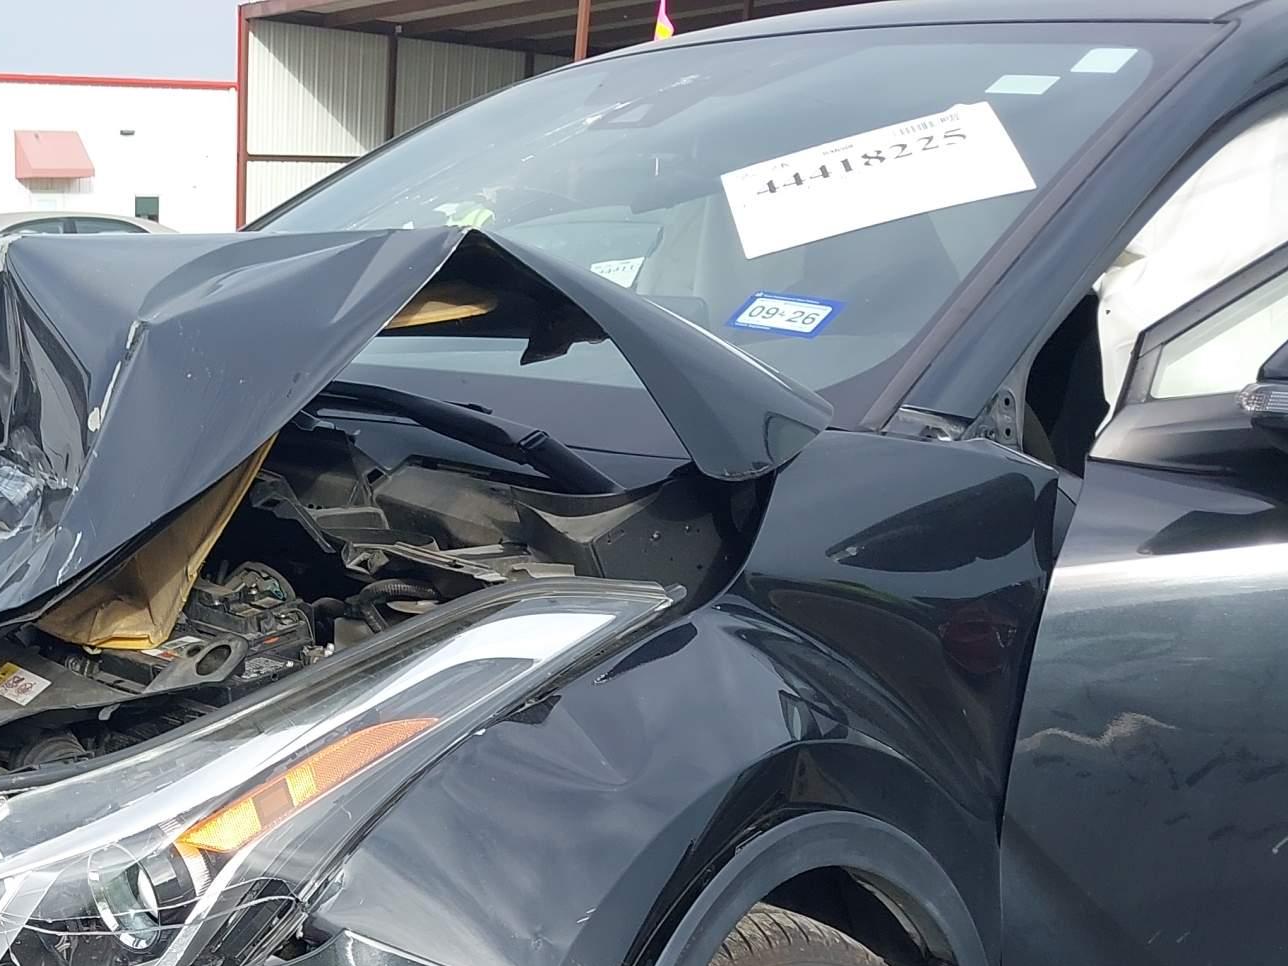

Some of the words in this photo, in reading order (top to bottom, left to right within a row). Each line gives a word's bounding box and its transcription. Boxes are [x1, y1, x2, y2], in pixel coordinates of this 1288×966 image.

[755, 127, 968, 195] 44418225
[748, 305, 780, 320] 09
[785, 310, 820, 326] 26
